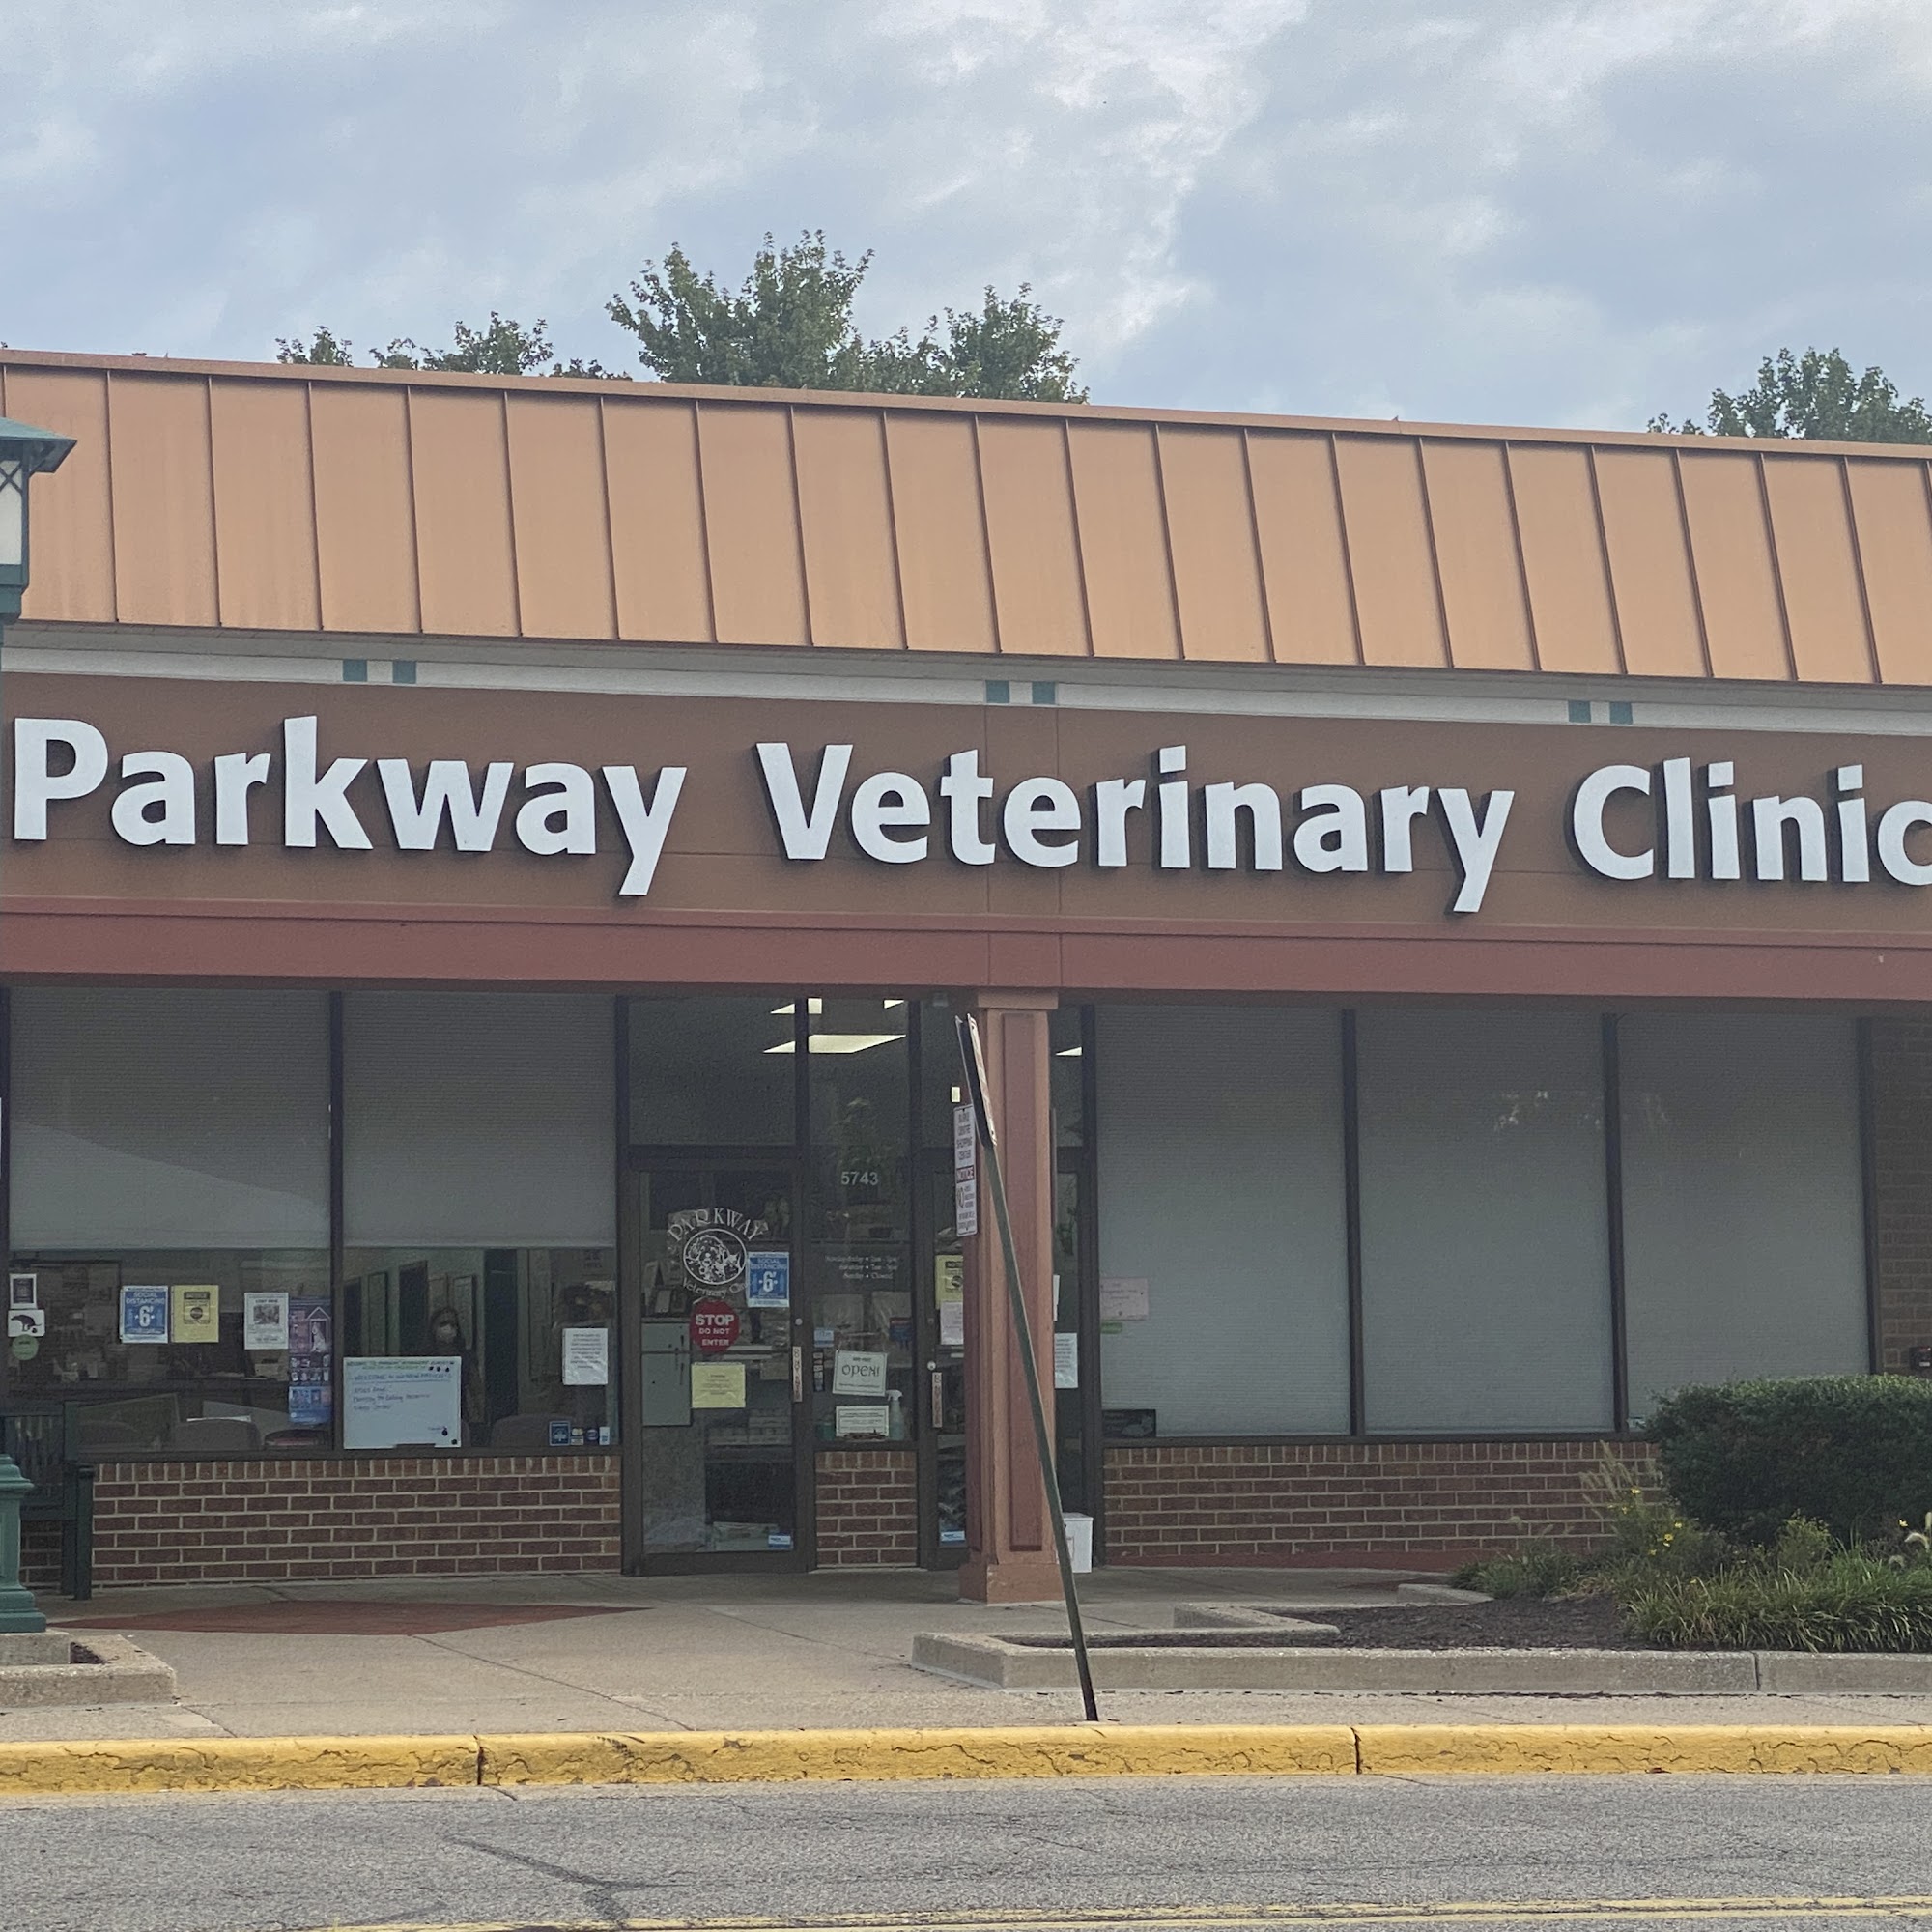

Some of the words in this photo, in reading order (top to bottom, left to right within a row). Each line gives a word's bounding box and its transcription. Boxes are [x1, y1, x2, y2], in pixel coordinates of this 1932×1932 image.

[14, 716, 687, 895] Parkway
[756, 743, 1515, 913] Veterinary
[1574, 757, 1932, 886] Clinic
[840, 1171, 878, 1186] 5743
[667, 1207, 769, 1242] PARKWAY
[696, 1314, 735, 1326] STOP
